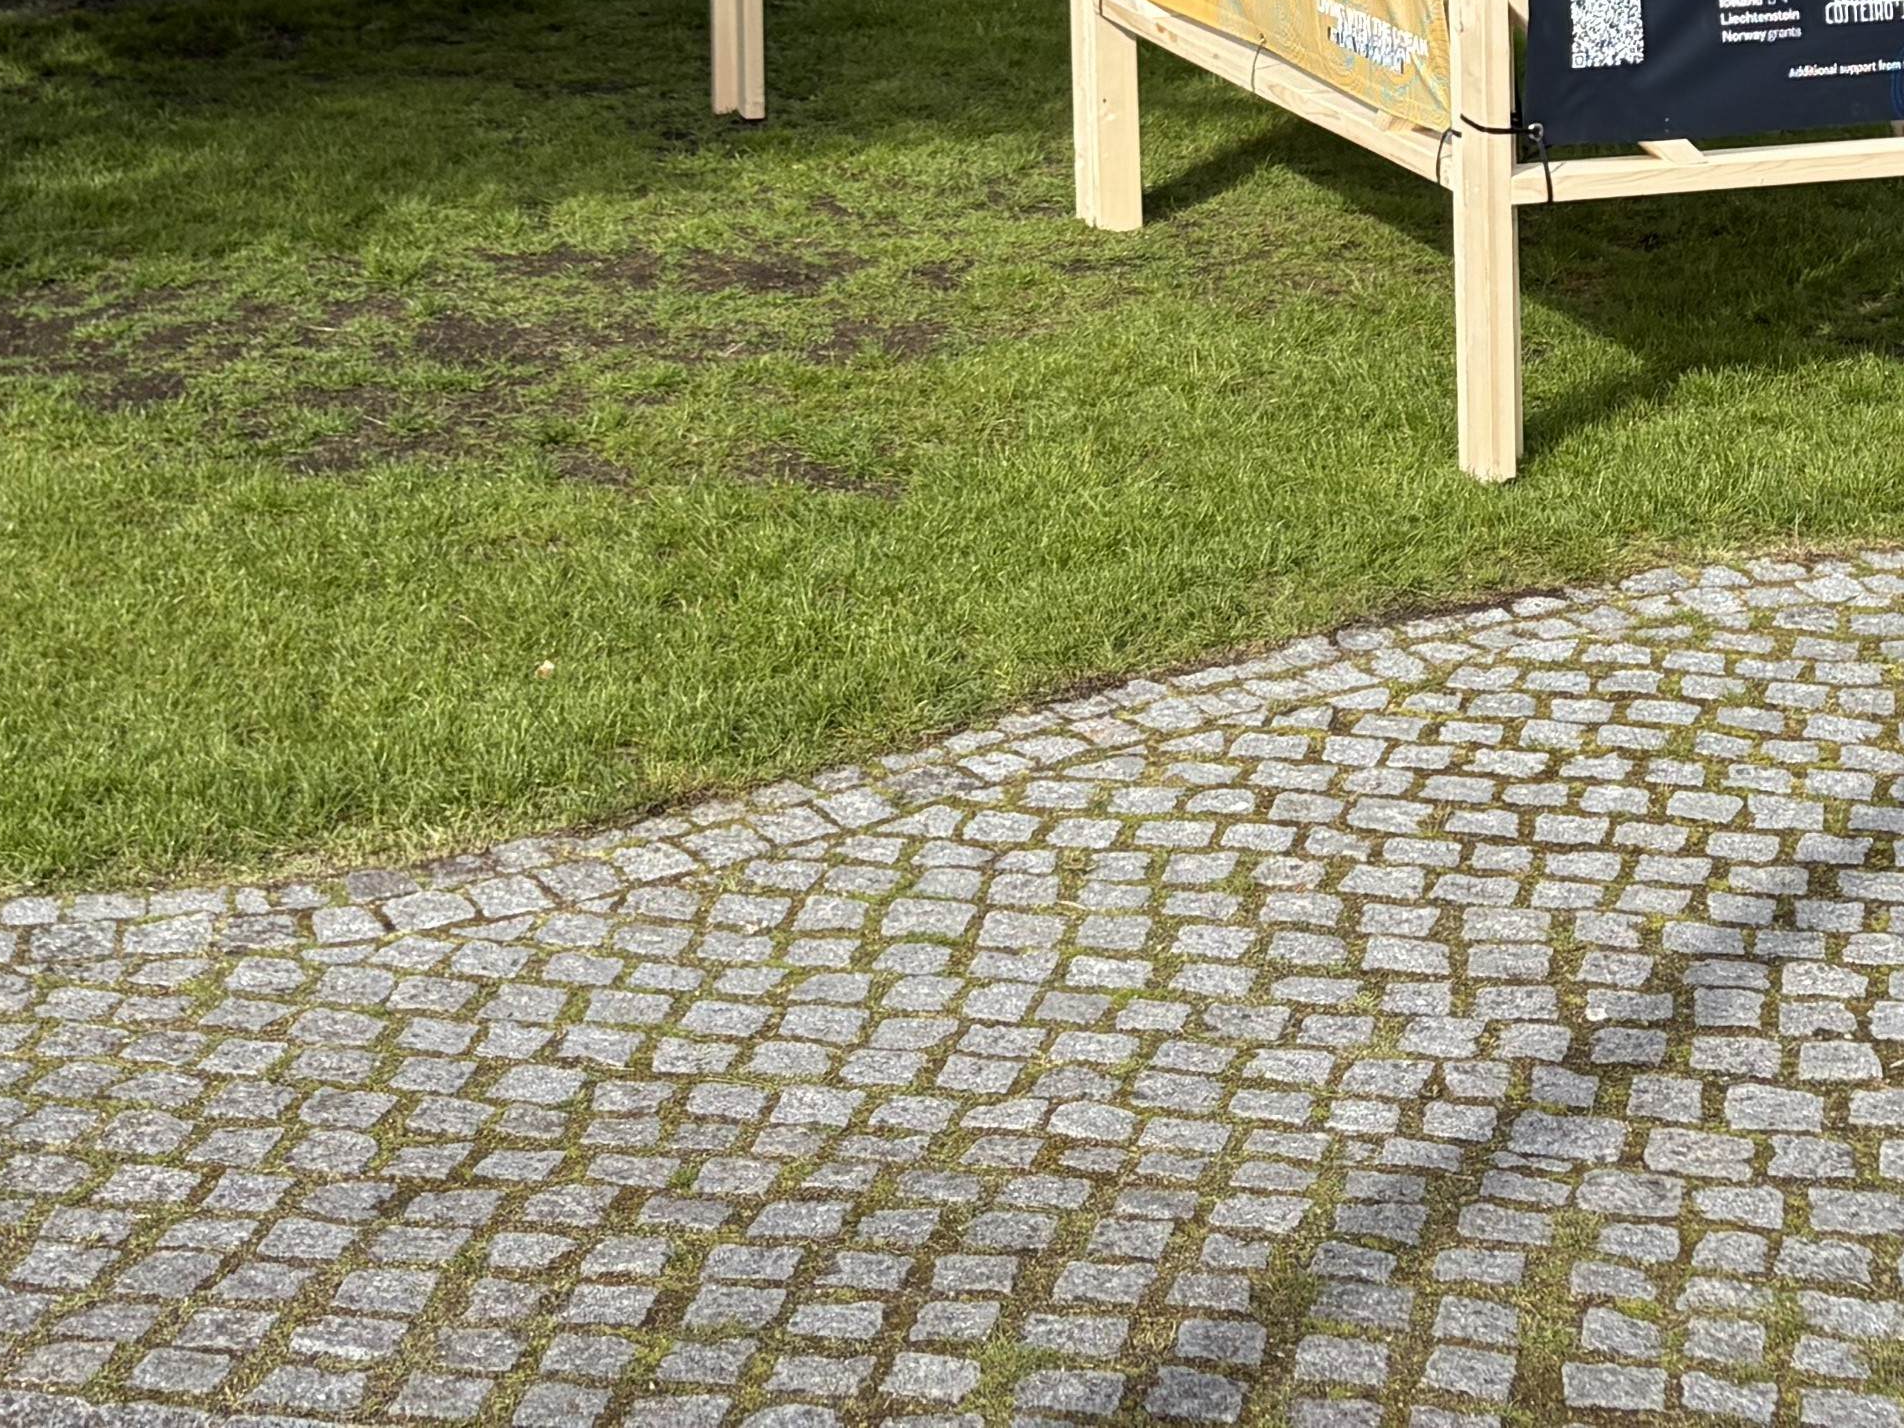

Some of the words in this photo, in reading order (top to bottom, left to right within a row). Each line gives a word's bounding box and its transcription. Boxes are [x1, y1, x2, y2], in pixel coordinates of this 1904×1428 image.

[1720, 8, 1801, 26] Liechtenstein
[1721, 27, 1767, 43] Norway
[1767, 25, 1803, 42] grants
[1788, 63, 1838, 78] Additional
[1839, 61, 1877, 76] support
[1878, 58, 1901, 71] from
